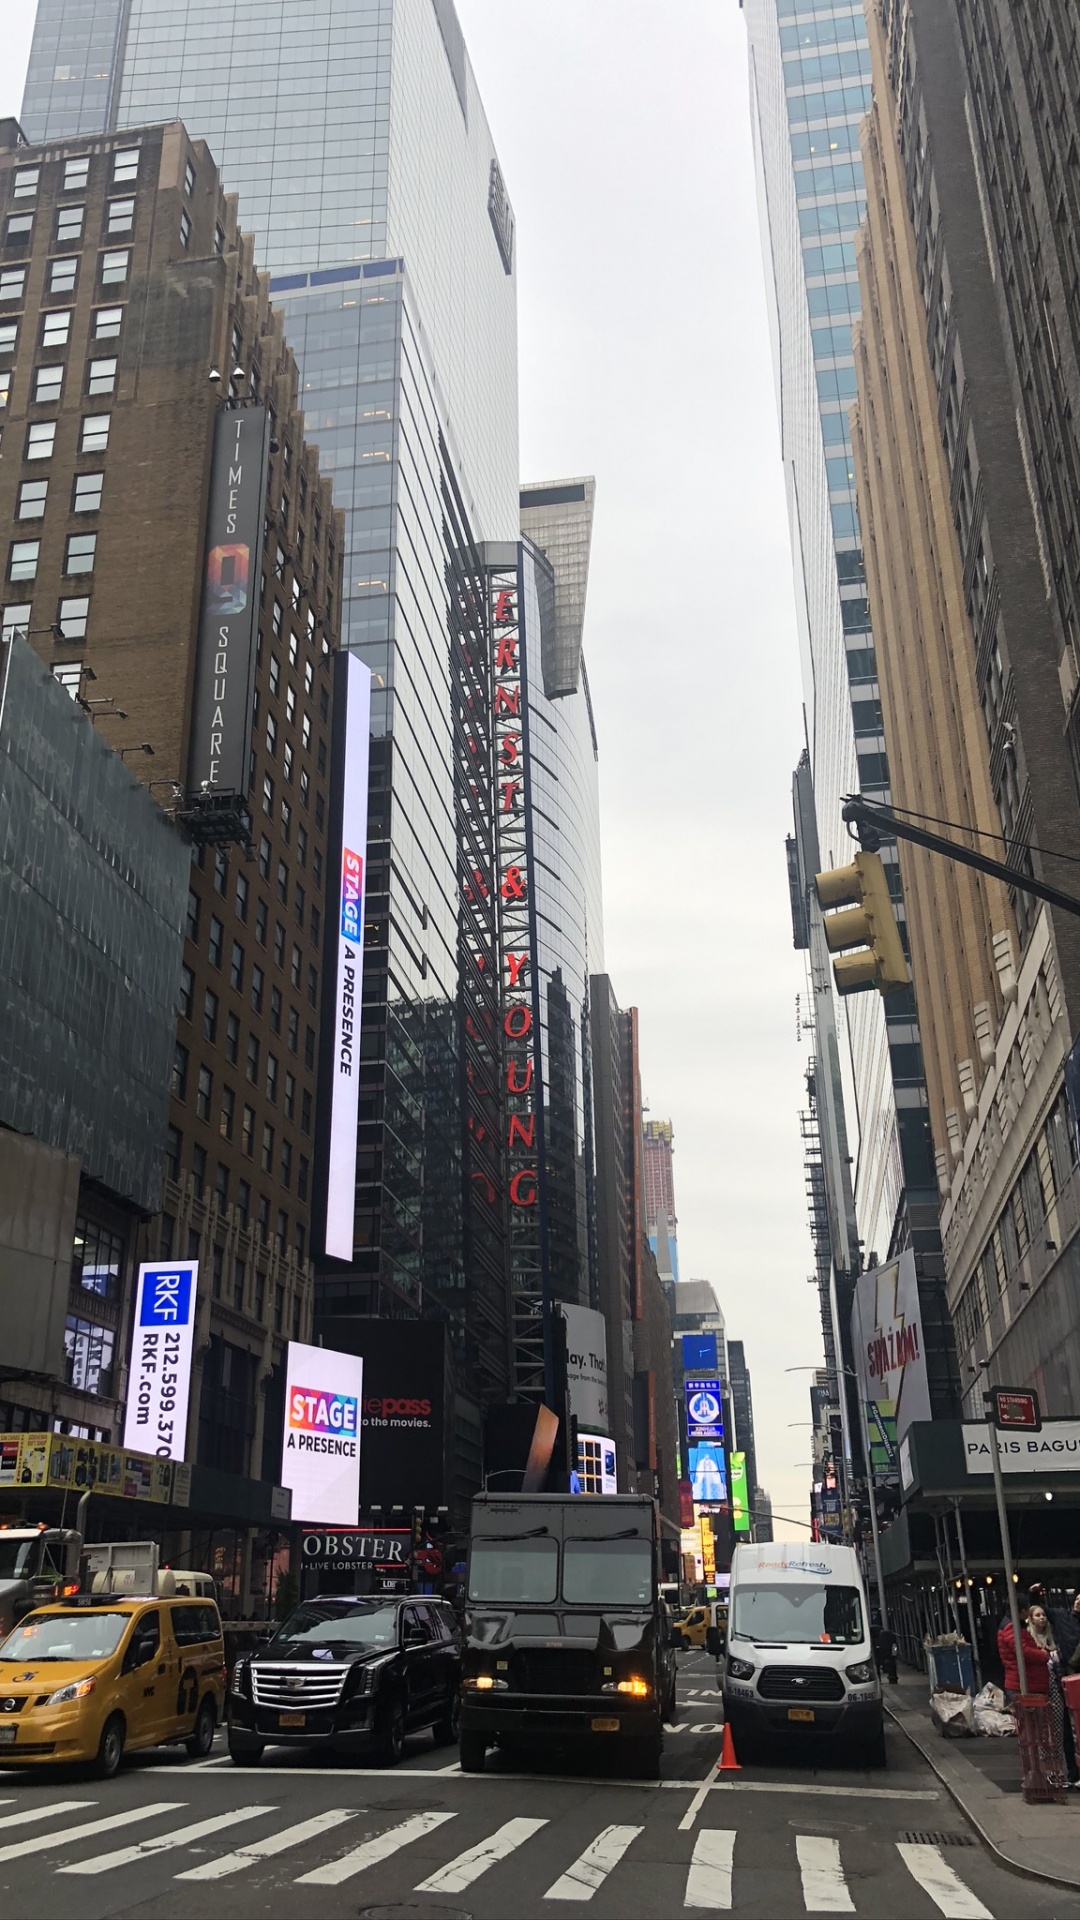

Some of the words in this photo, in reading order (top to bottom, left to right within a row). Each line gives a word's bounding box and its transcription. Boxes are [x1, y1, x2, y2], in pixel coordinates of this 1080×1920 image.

[226, 418, 245, 535] TIMES
[208, 625, 230, 785] SQUARE
[494, 590, 521, 812] ERNST
[344, 853, 361, 939] STAGE
[500, 865, 526, 899] &
[344, 944, 356, 960] A
[340, 964, 356, 1077] PRESENCE
[504, 952, 537, 1207] YOUNG
[153, 1275, 181, 1321] RKF
[867, 1322, 921, 1378] SHAZAM!
[136, 1333, 159, 1425] RKF.com
[291, 1393, 355, 1431] STAGE
[363, 1395, 432, 1417] iepass
[1007, 1397, 1028, 1405] STANDING
[371, 1417, 388, 1427] the
[390, 1418, 431, 1428] movies.
[870, 1404, 894, 1459] #GarmentDistrict
[287, 1432, 296, 1450] A
[298, 1433, 357, 1458] PRESENCE
[1027, 1439, 1080, 1453] BAGU
[303, 1535, 403, 1562] OBSTER
[309, 1562, 329, 1570] LIVE
[332, 1561, 373, 1570] LOBSTER
[758, 1560, 826, 1570] ReadyRefresh
